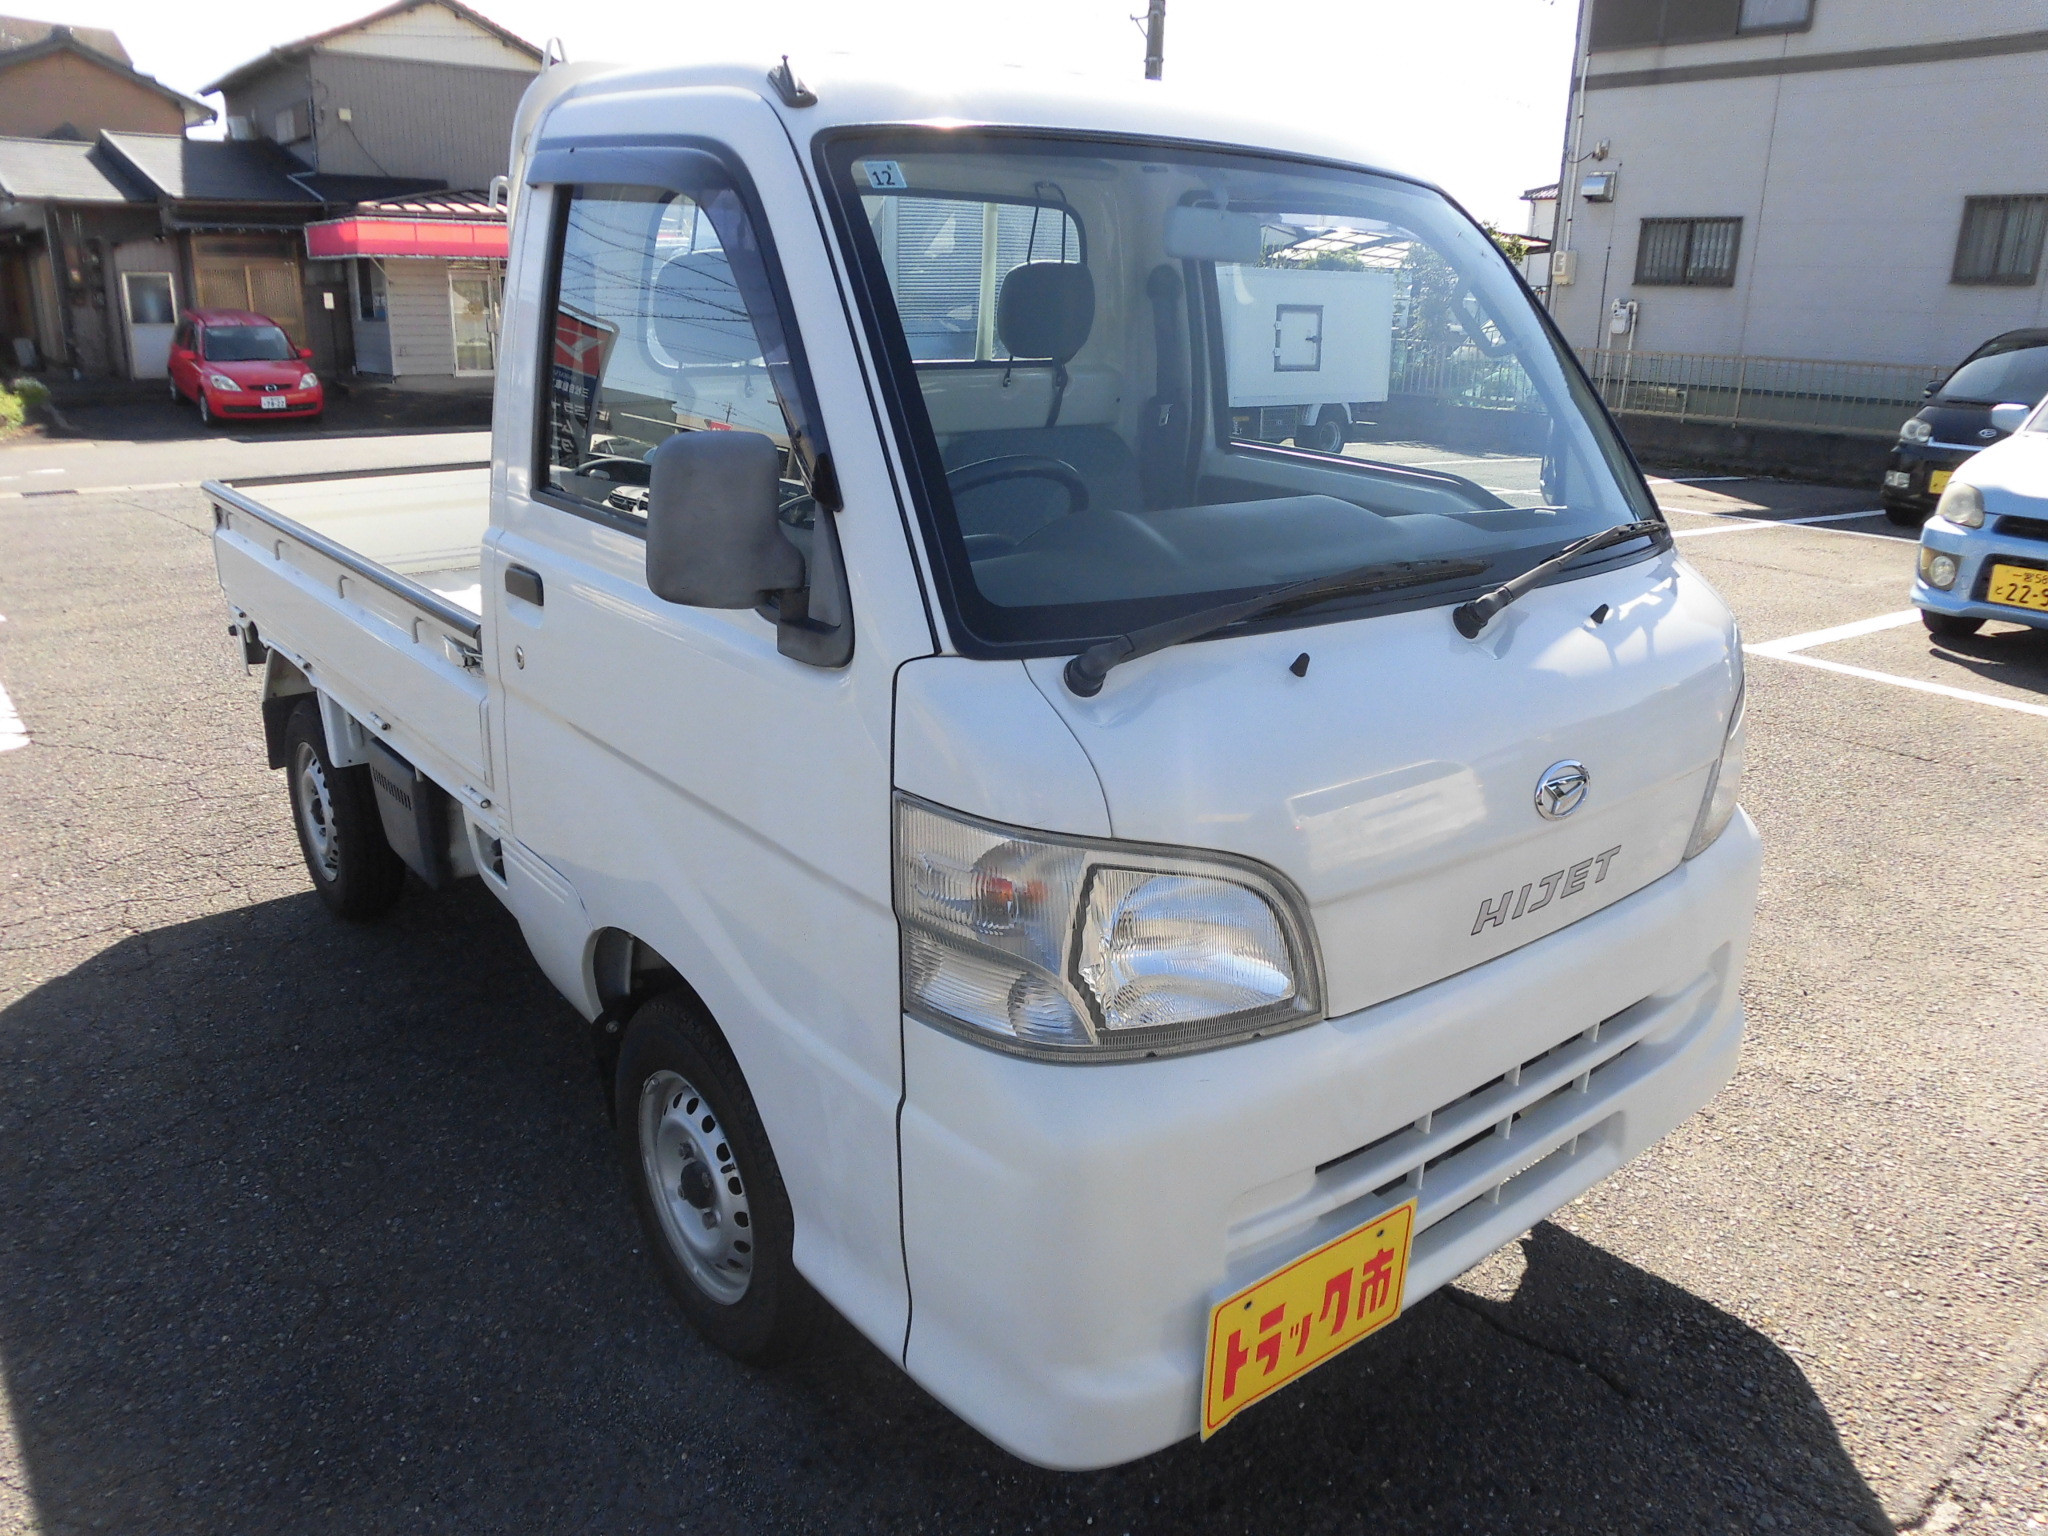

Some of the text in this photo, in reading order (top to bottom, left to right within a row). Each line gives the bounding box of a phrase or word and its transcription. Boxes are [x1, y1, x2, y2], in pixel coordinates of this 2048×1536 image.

[873, 171, 895, 185] 12
[1471, 844, 1622, 936] HIJET
[1222, 1247, 1395, 1403] トラック市
